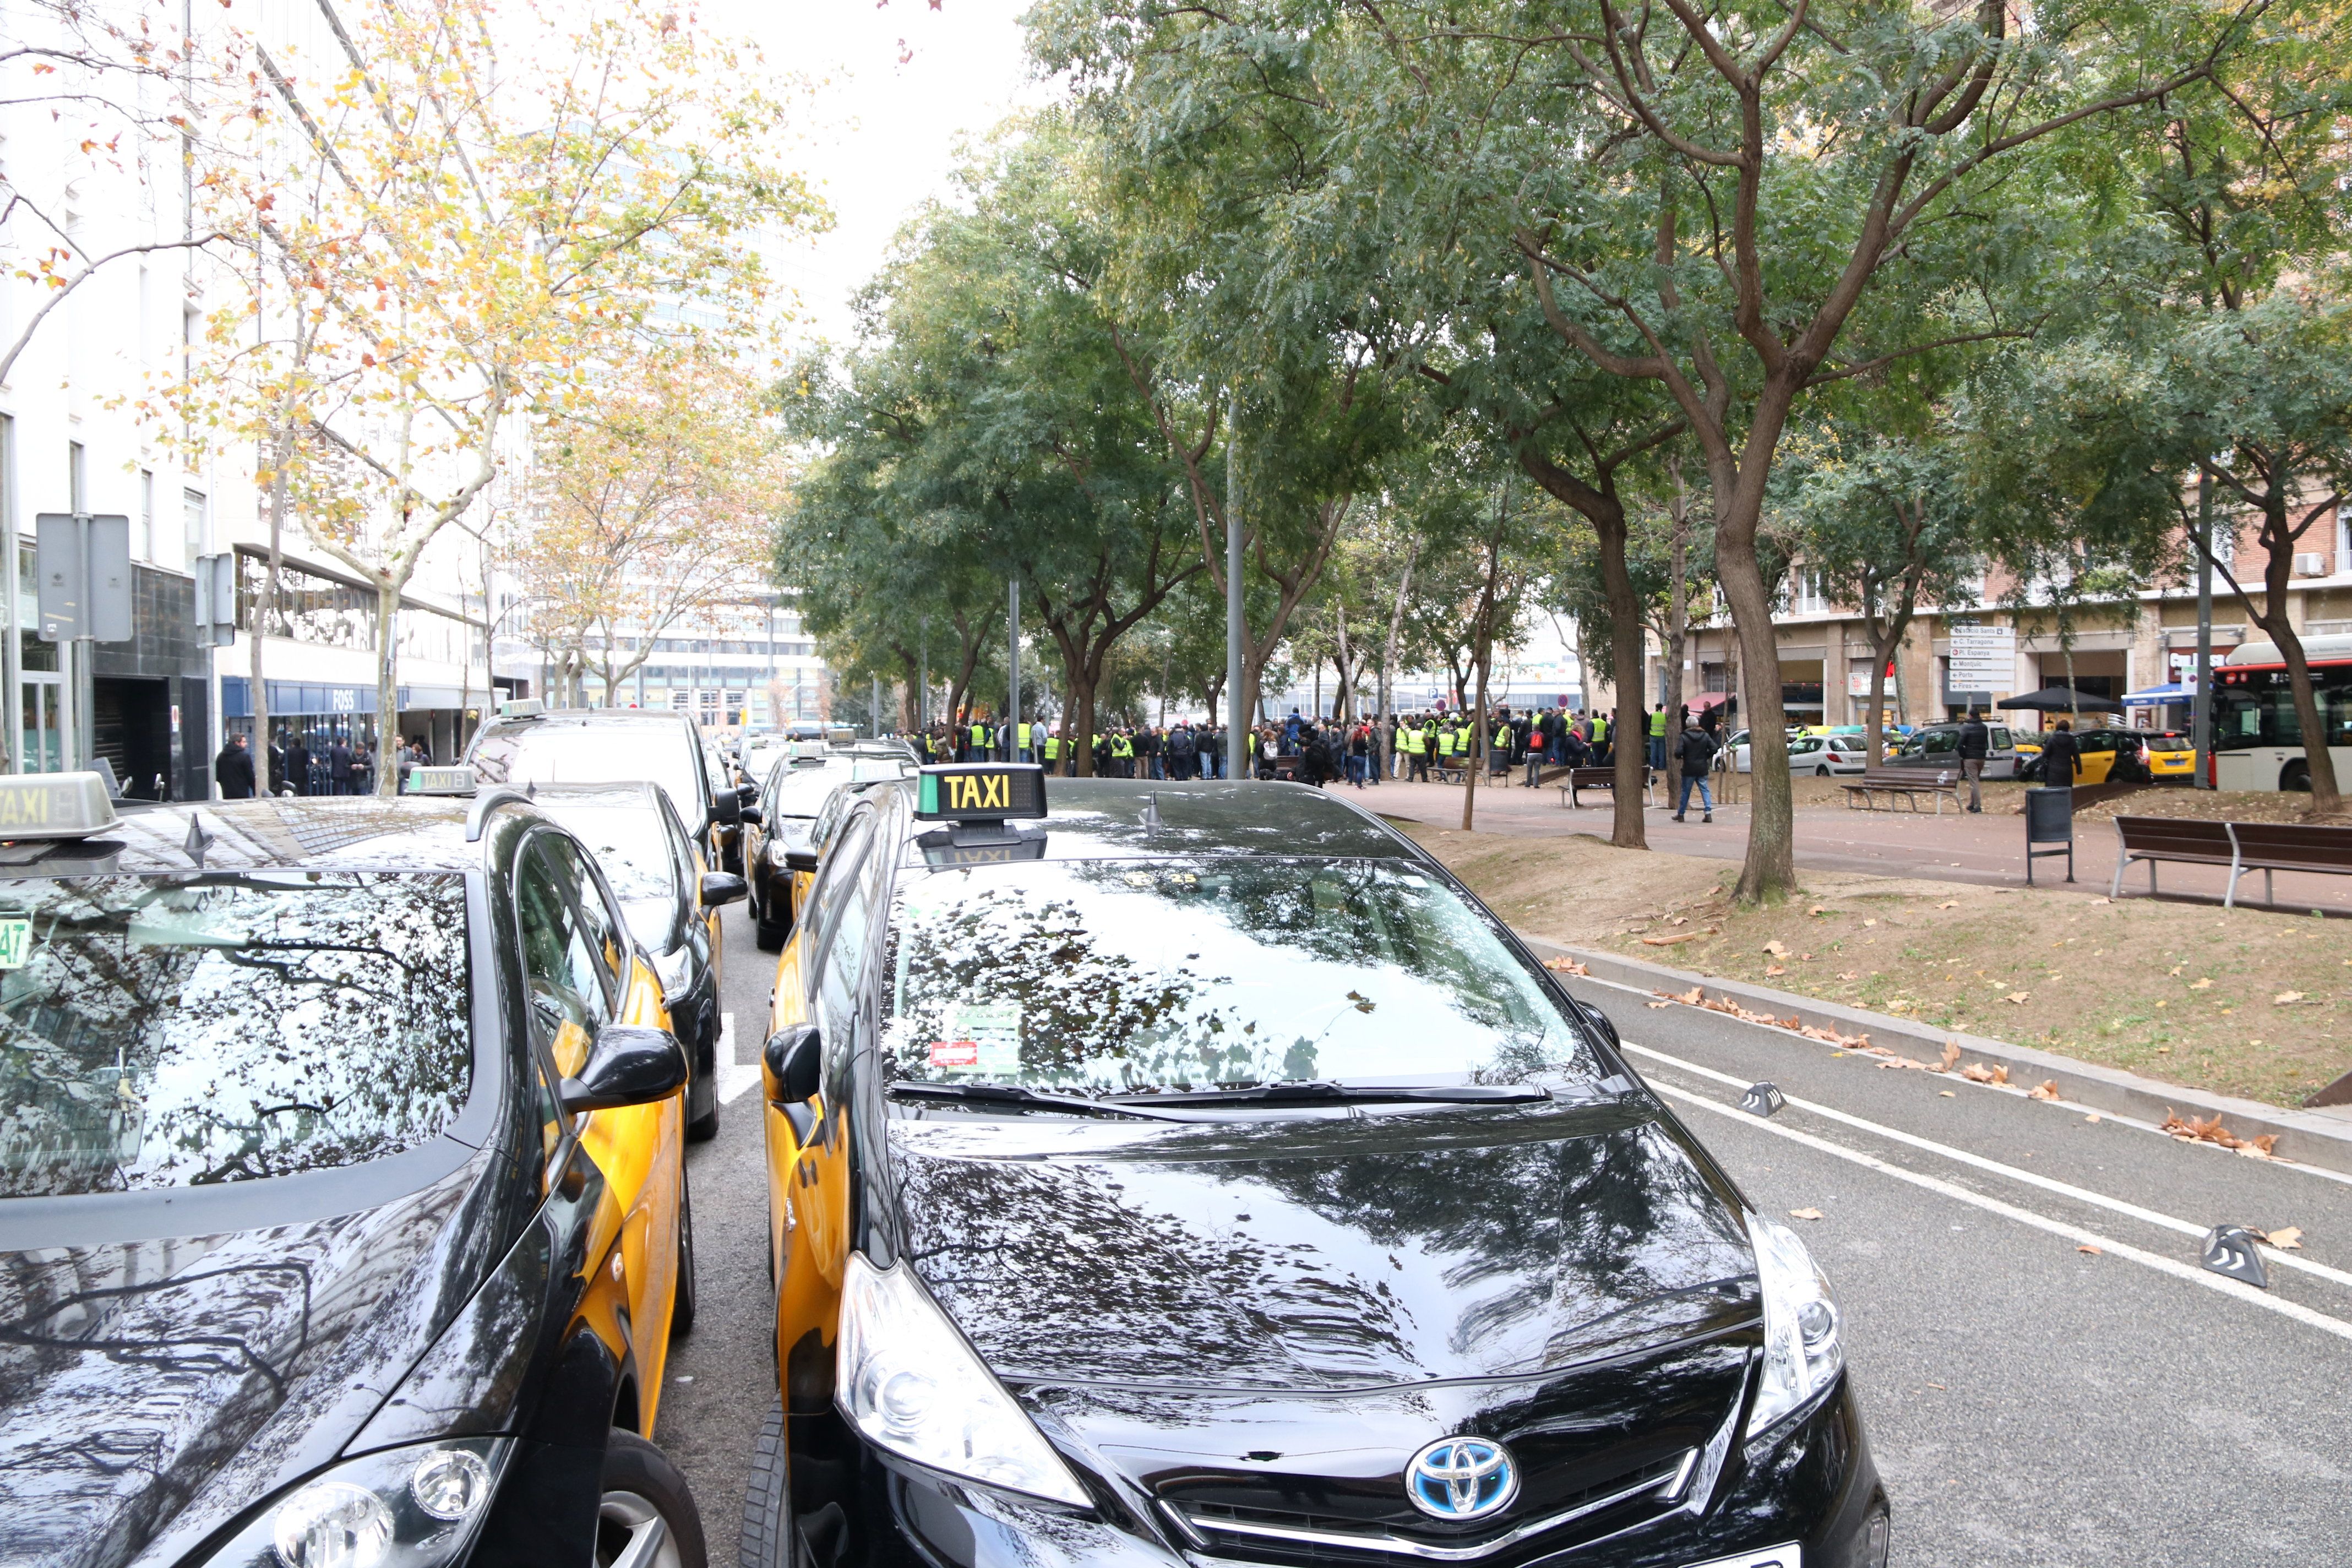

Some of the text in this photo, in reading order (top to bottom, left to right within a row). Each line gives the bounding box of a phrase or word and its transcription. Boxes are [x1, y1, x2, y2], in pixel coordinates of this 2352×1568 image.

[333, 689, 354, 711] FOSS
[511, 703, 529, 714] TAXI
[423, 772, 450, 788] TAXI
[944, 775, 1009, 809] TAXI
[0, 788, 47, 824] AXI
[1170, 873, 1197, 883] 25
